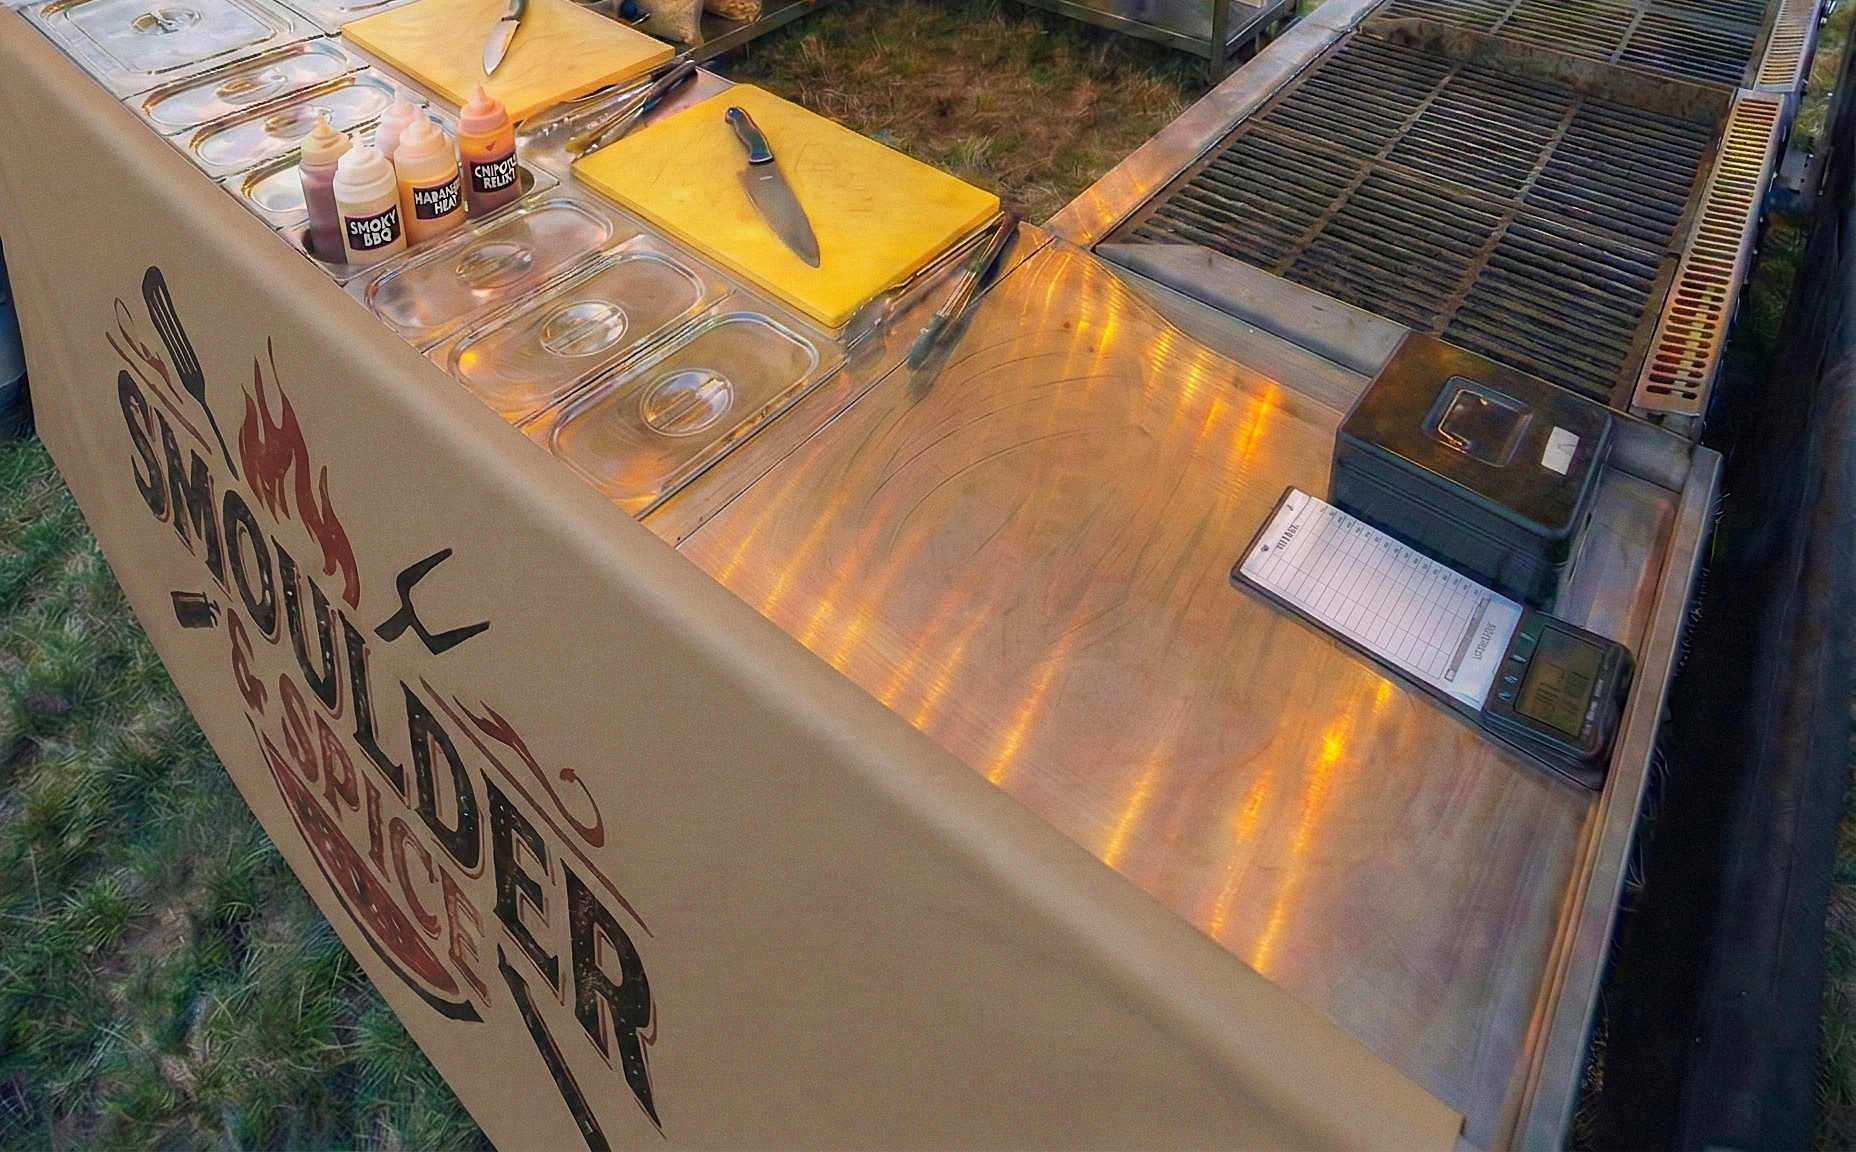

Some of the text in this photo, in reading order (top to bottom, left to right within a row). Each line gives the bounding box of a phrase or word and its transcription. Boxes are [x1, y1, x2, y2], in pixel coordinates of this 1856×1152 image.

[350, 208, 397, 235] SMOKY
[363, 227, 392, 247] BBQ
[118, 369, 662, 1138] SMOULDER
[278, 672, 492, 1009] SPICE
